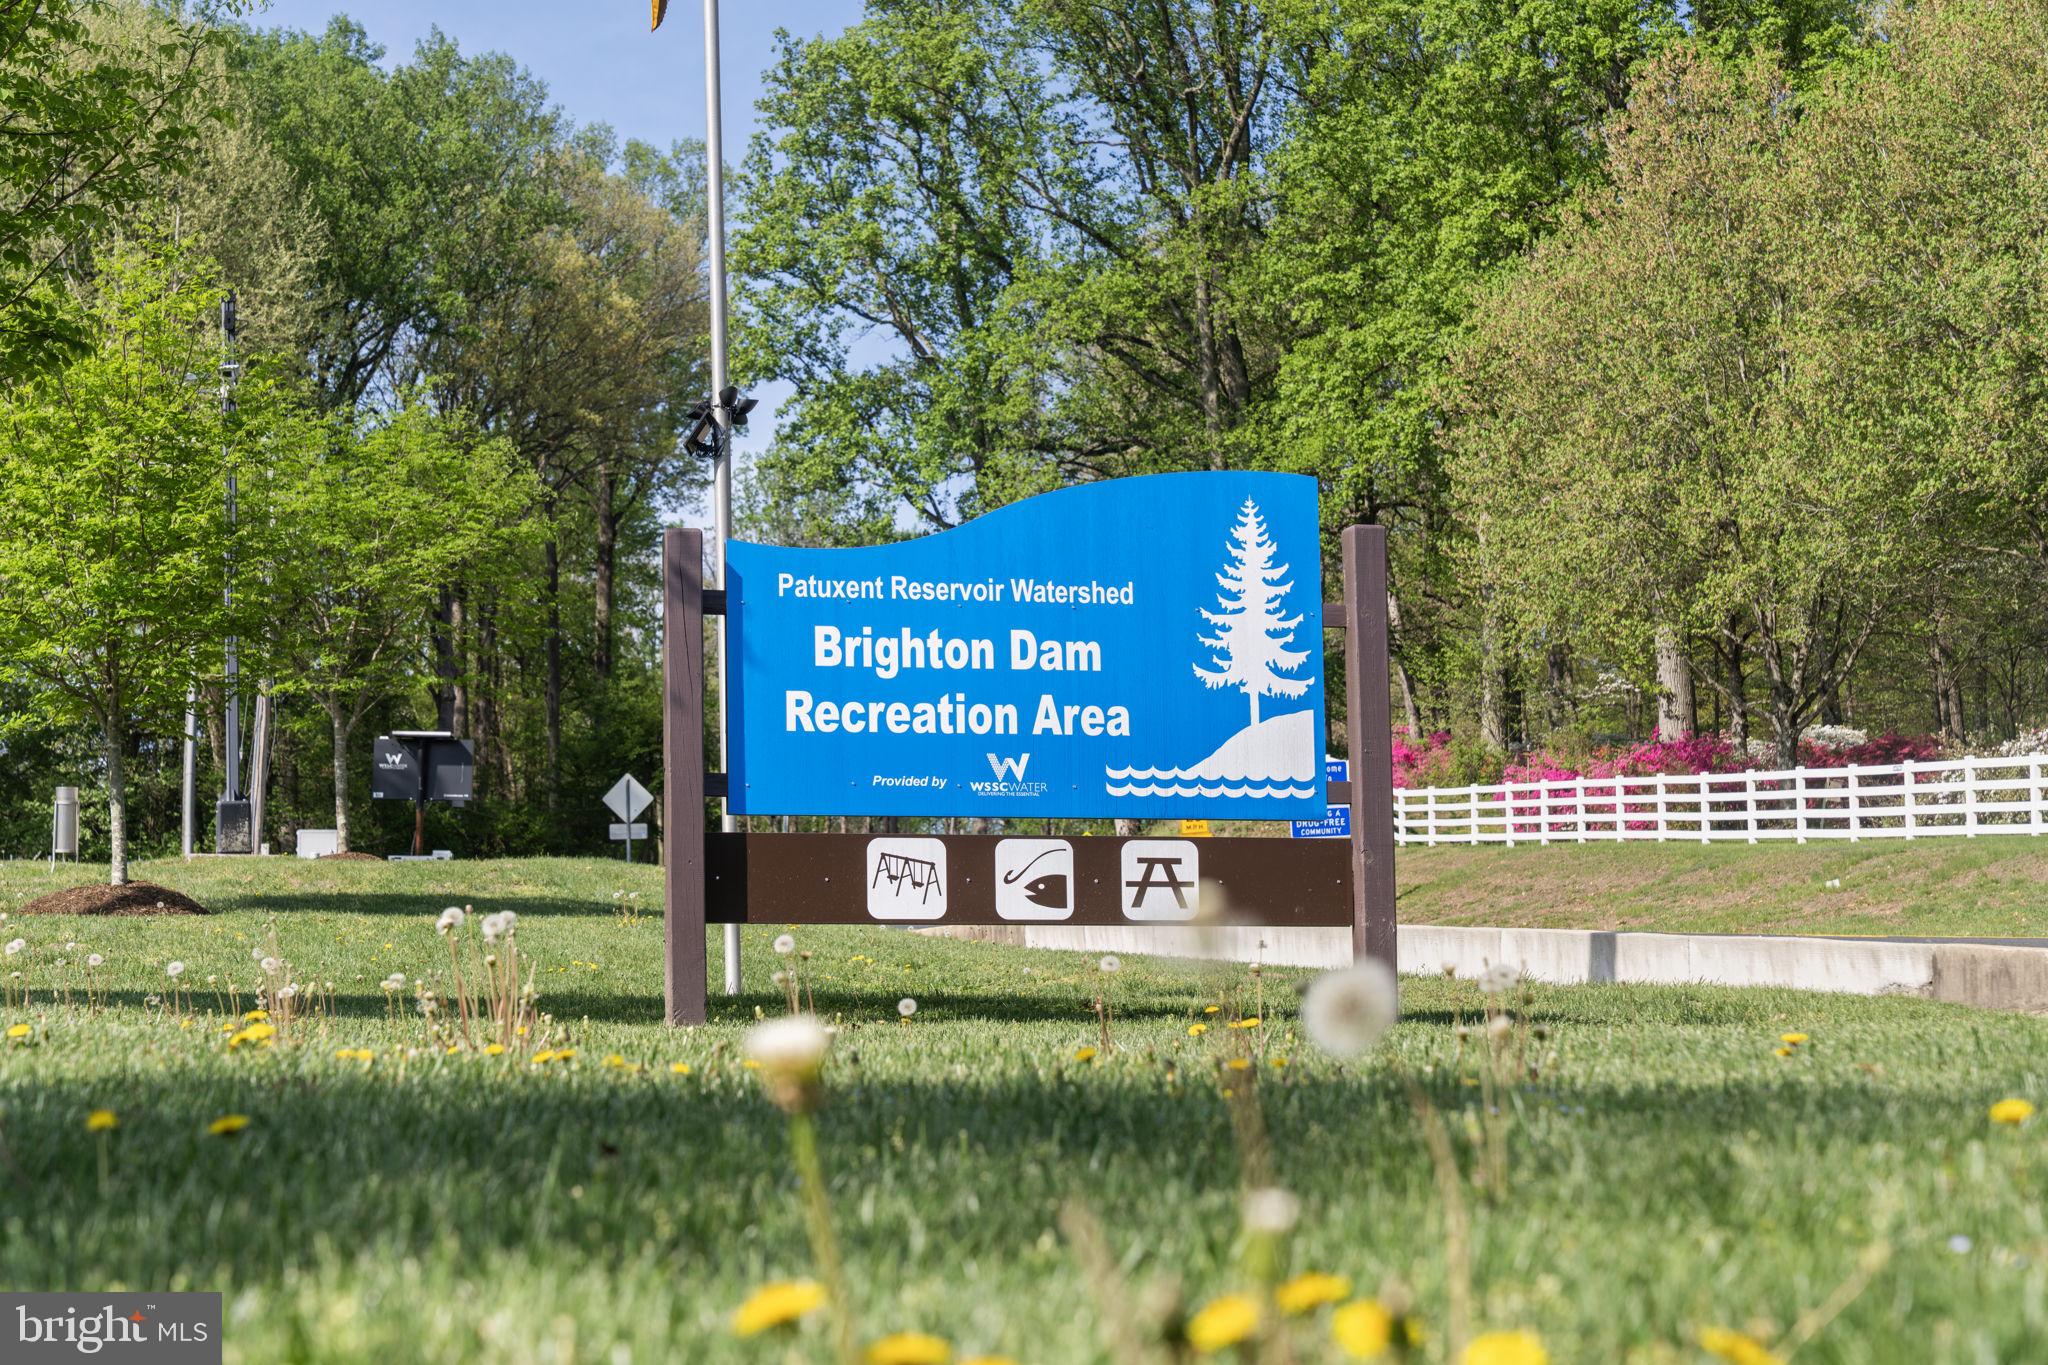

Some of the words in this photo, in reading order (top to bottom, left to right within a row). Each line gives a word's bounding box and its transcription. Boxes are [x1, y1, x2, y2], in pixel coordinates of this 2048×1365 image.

[778, 573, 884, 599] Patuxent
[891, 575, 1005, 601] Reservoir
[1010, 578, 1134, 605] Watershed
[814, 625, 995, 680] Brighton
[1010, 629, 1102, 672] Dam
[785, 690, 1018, 735] Recreation
[1032, 694, 1131, 737] Area
[872, 775, 929, 787] Provided
[931, 775, 947, 790] by
[1296, 817, 1346, 828] DRUG-FREE
[1300, 827, 1342, 836] COMMUNITY
